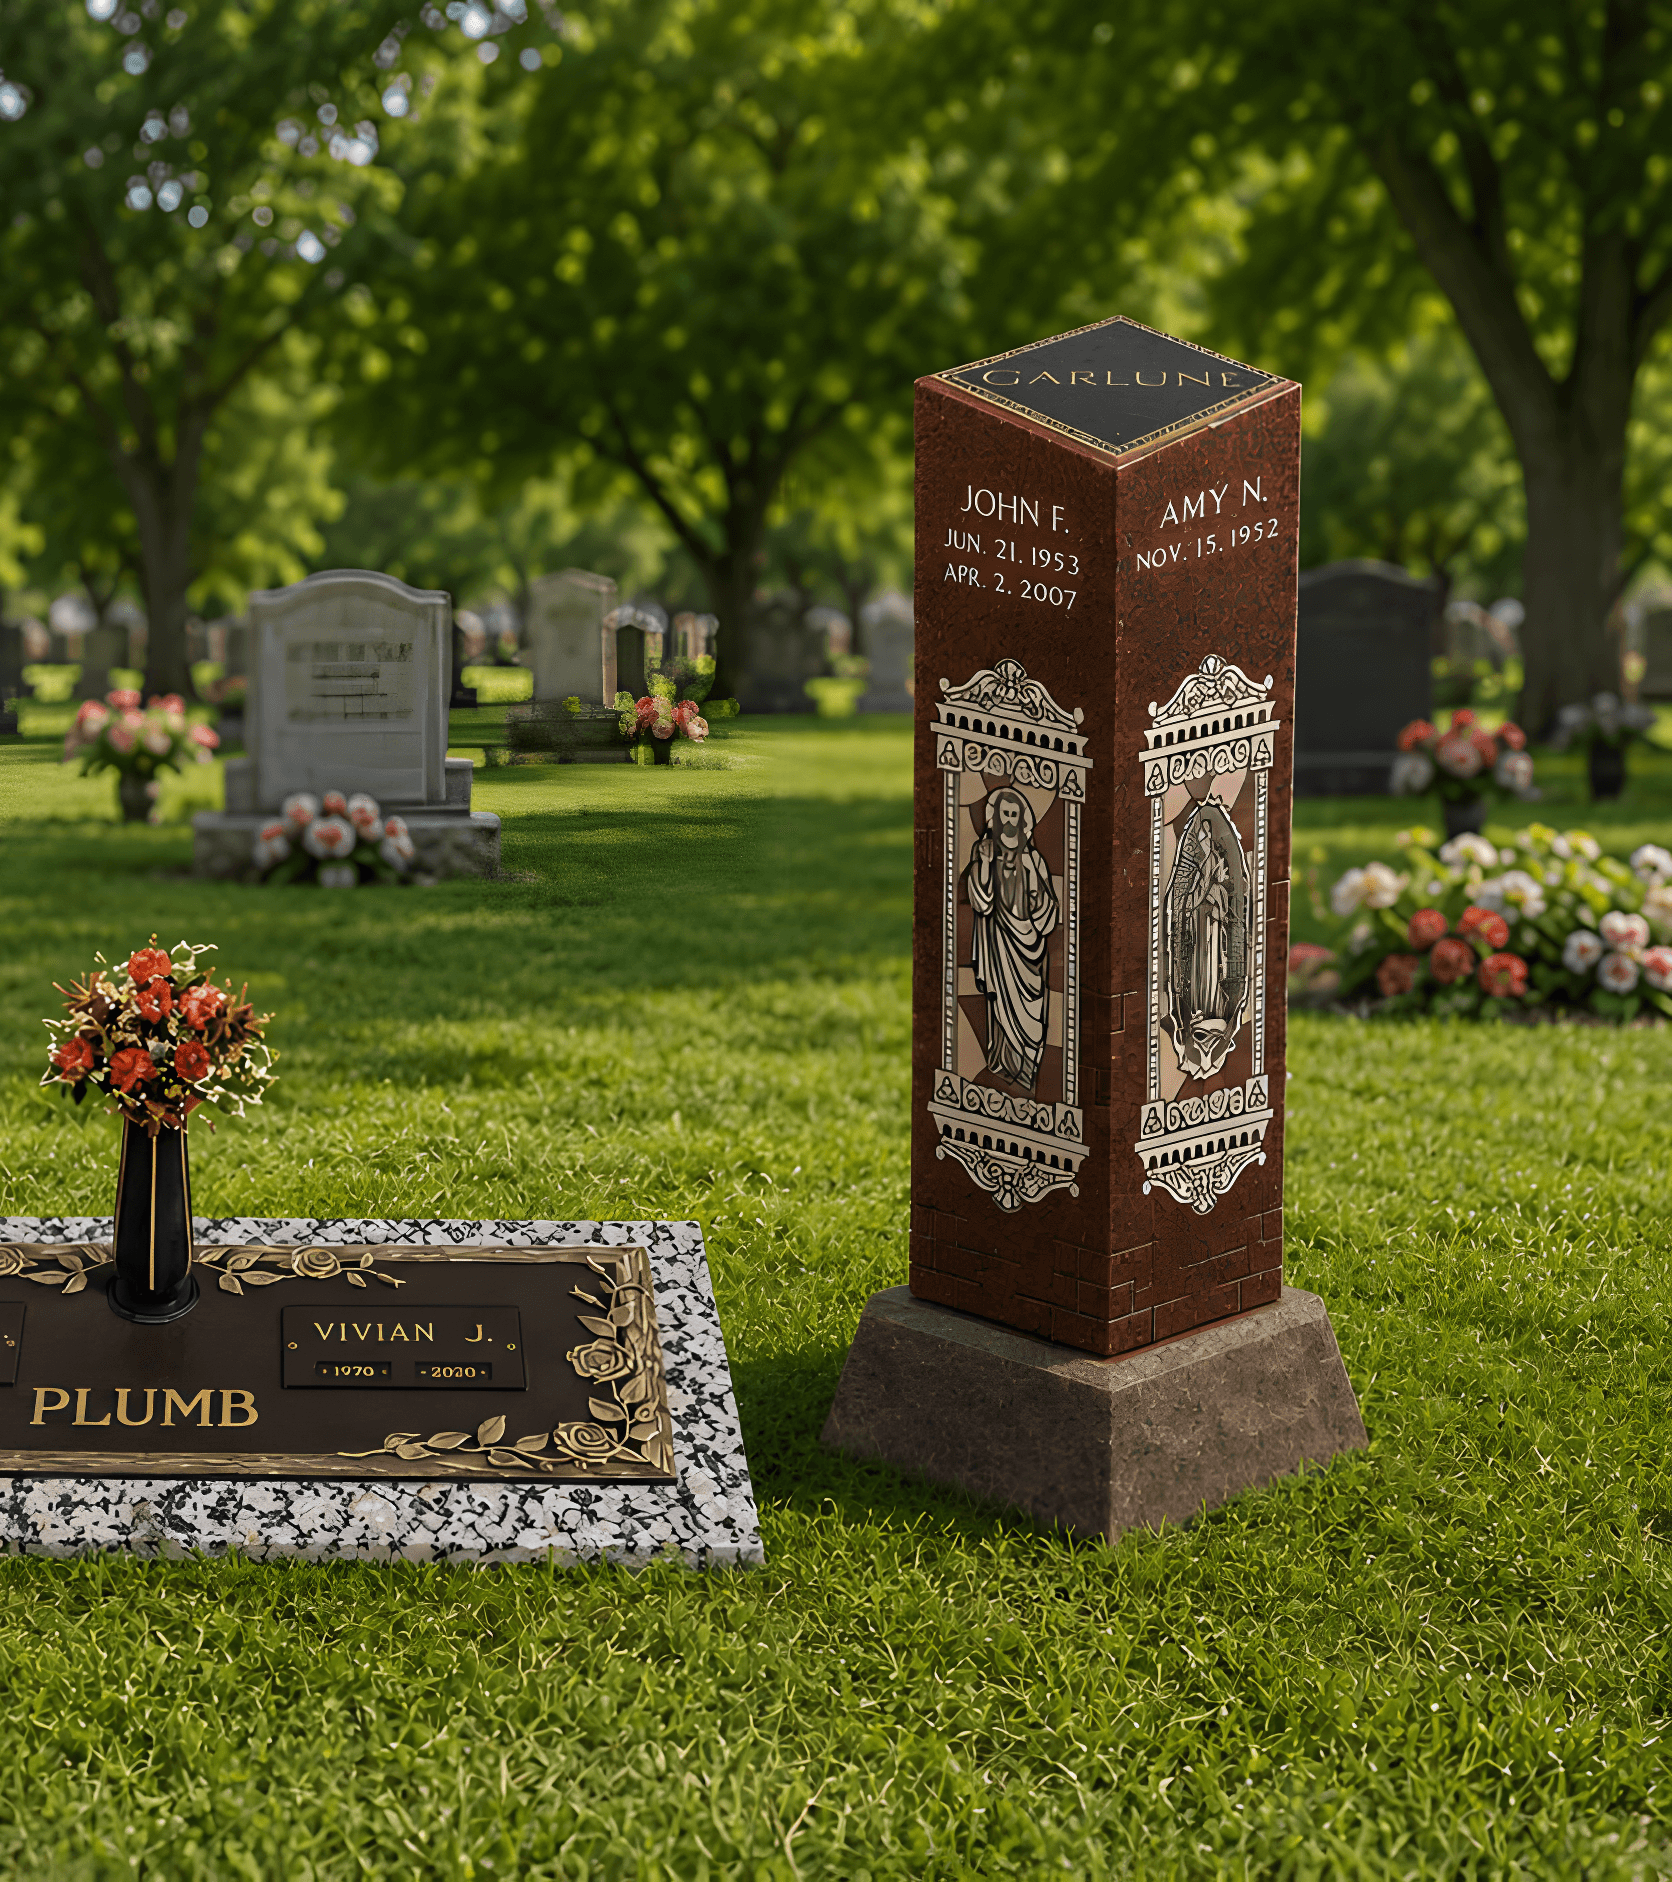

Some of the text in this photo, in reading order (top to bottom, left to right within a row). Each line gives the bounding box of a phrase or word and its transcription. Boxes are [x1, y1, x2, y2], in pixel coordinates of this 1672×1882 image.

[960, 484, 1070, 534] JOHN F.
[1159, 475, 1268, 529] AMY N.
[944, 528, 1079, 576] JUN. 21. 1953
[1136, 518, 1279, 572] NOV. 15. 1952
[943, 562, 1077, 610] APR. 2. 2007
[312, 1322, 494, 1343] VIVIAN J.
[28, 1387, 260, 1428] PLUMB
